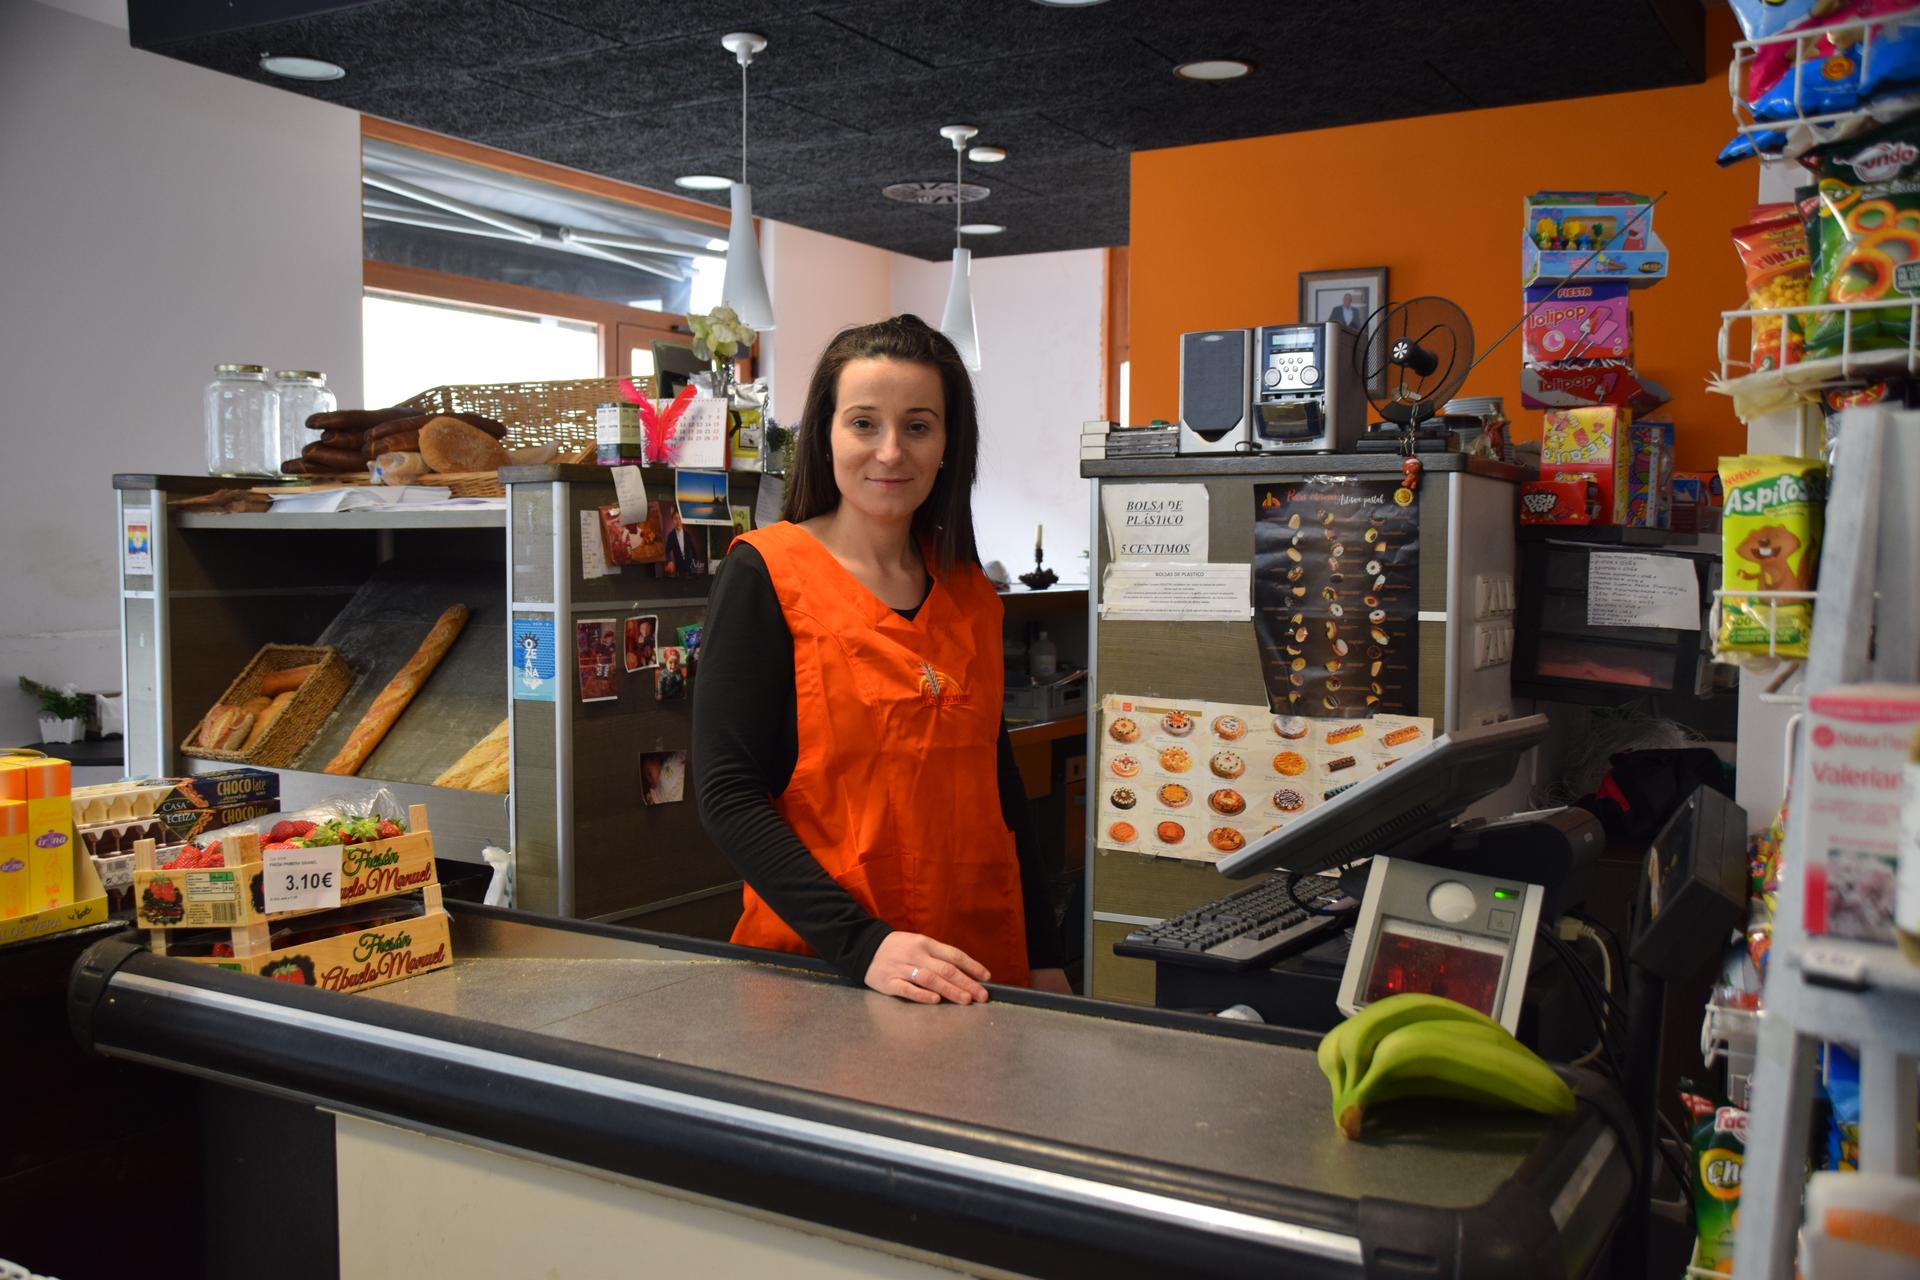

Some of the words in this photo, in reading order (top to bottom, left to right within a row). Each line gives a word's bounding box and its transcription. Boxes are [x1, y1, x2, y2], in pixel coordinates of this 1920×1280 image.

[1557, 287, 1592, 298] FIESTA
[1530, 305, 1587, 328] lolipop
[1537, 376, 1595, 392] lolipop
[1523, 493, 1558, 505] PUSH
[1126, 500, 1164, 512] BOLSA
[1528, 502, 1554, 513] POP
[1120, 544, 1127, 554] 5
[1129, 543, 1191, 554] CENTIMOS
[162, 800, 187, 812] CASA
[286, 871, 333, 891] 3.10€
